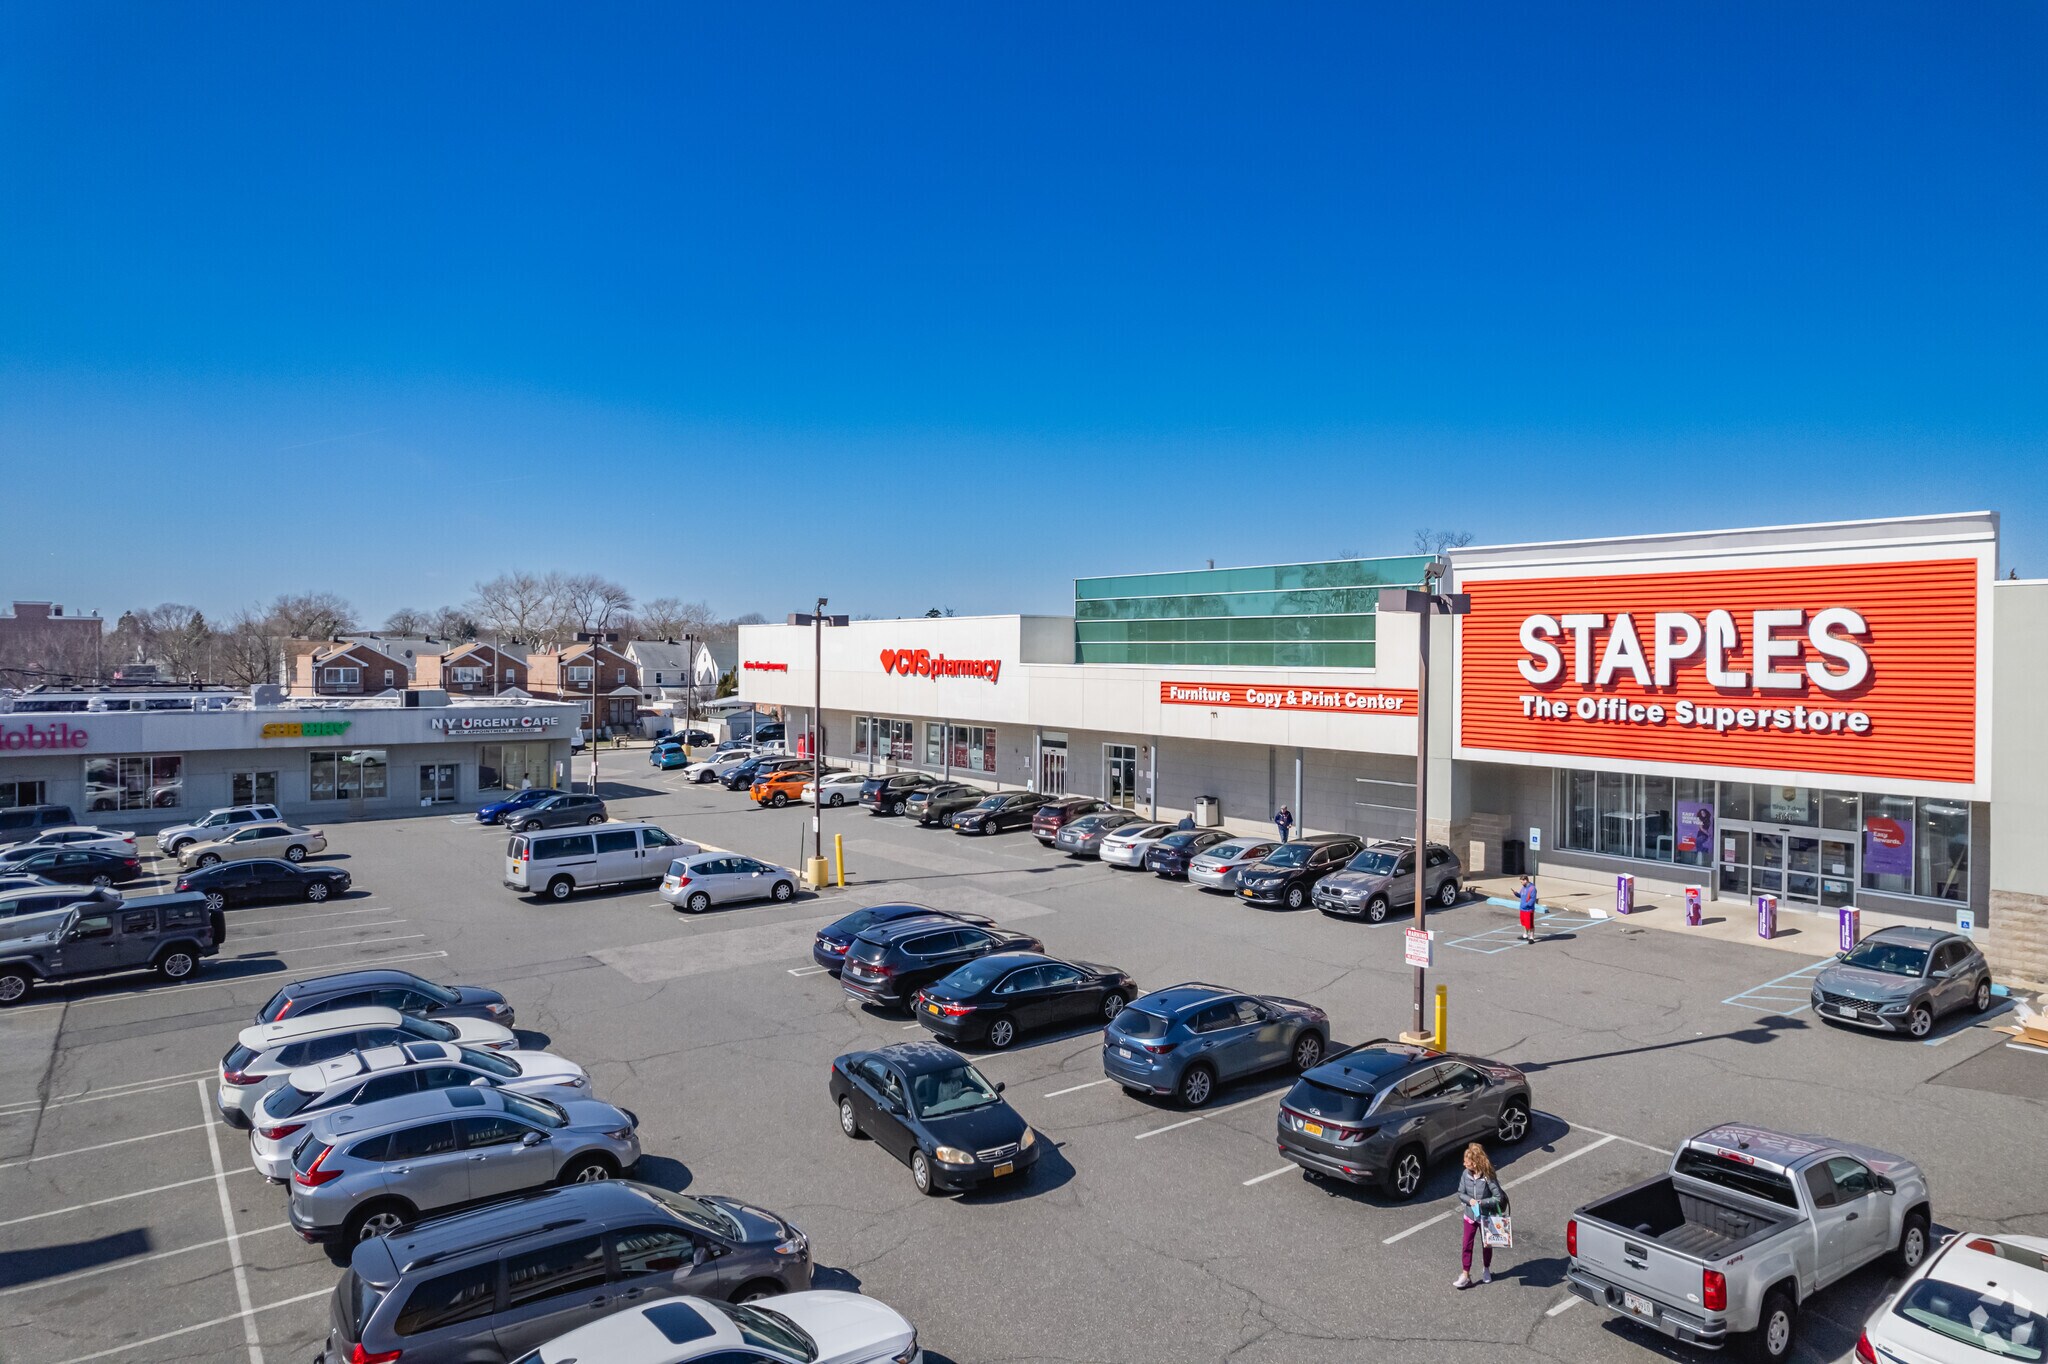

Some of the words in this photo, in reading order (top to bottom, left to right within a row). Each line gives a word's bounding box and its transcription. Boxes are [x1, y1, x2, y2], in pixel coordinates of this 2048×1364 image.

[1517, 607, 1868, 691] STAPLES
[895, 649, 930, 675] CVS
[931, 653, 1000, 683] pharmacy
[1170, 686, 1231, 702] Furniture
[1246, 689, 1282, 708] Copy
[1286, 690, 1298, 705] &
[1302, 691, 1341, 707] Print
[1345, 692, 1404, 709] Center
[432, 718, 456, 729] NY
[462, 717, 518, 729] URGENT
[521, 716, 558, 727] CARE
[1519, 695, 1569, 718] The
[1576, 697, 1665, 723] Office
[1675, 700, 1870, 731] Superstore
[0, 723, 88, 750] obile
[260, 721, 352, 739] SUBWAY
[1873, 831, 1888, 839] Easy
[1408, 930, 1428, 939] WARNING
